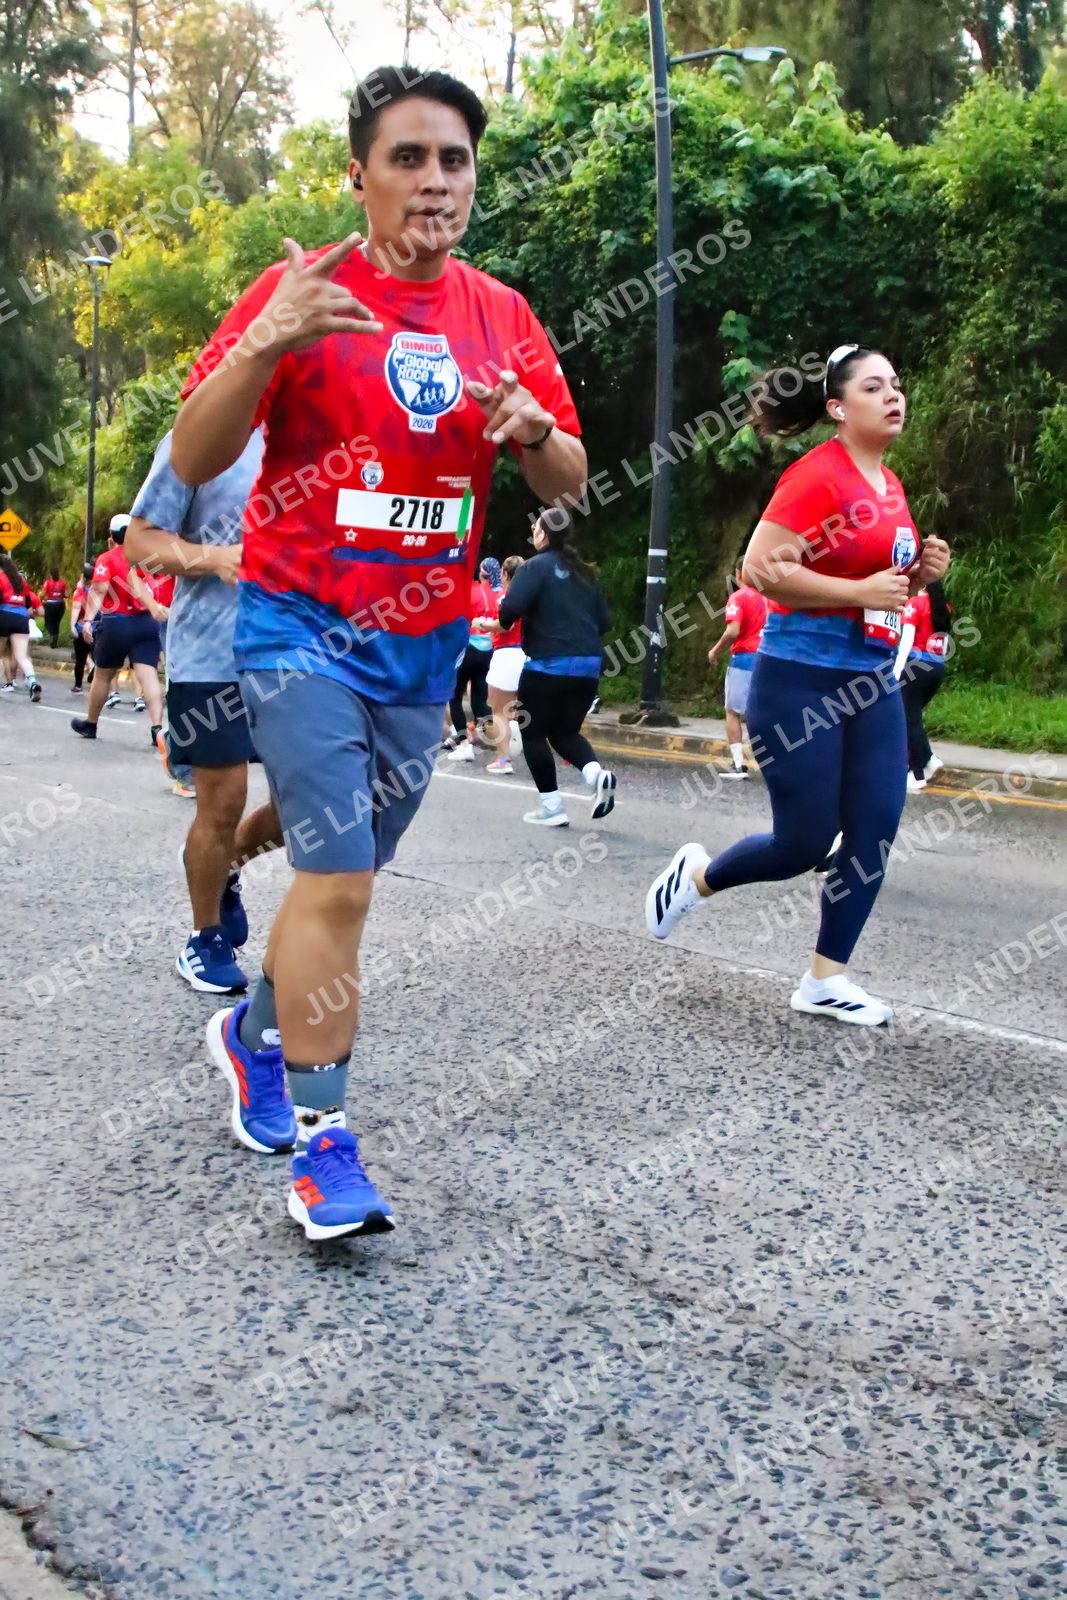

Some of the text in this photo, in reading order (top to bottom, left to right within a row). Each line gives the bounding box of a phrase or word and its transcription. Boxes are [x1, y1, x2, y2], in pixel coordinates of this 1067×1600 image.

[401, 340, 443, 354] BIMBO
[404, 354, 443, 372] Global
[397, 364, 429, 383] Race
[411, 417, 434, 430] 2026
[389, 497, 445, 529] 2718
